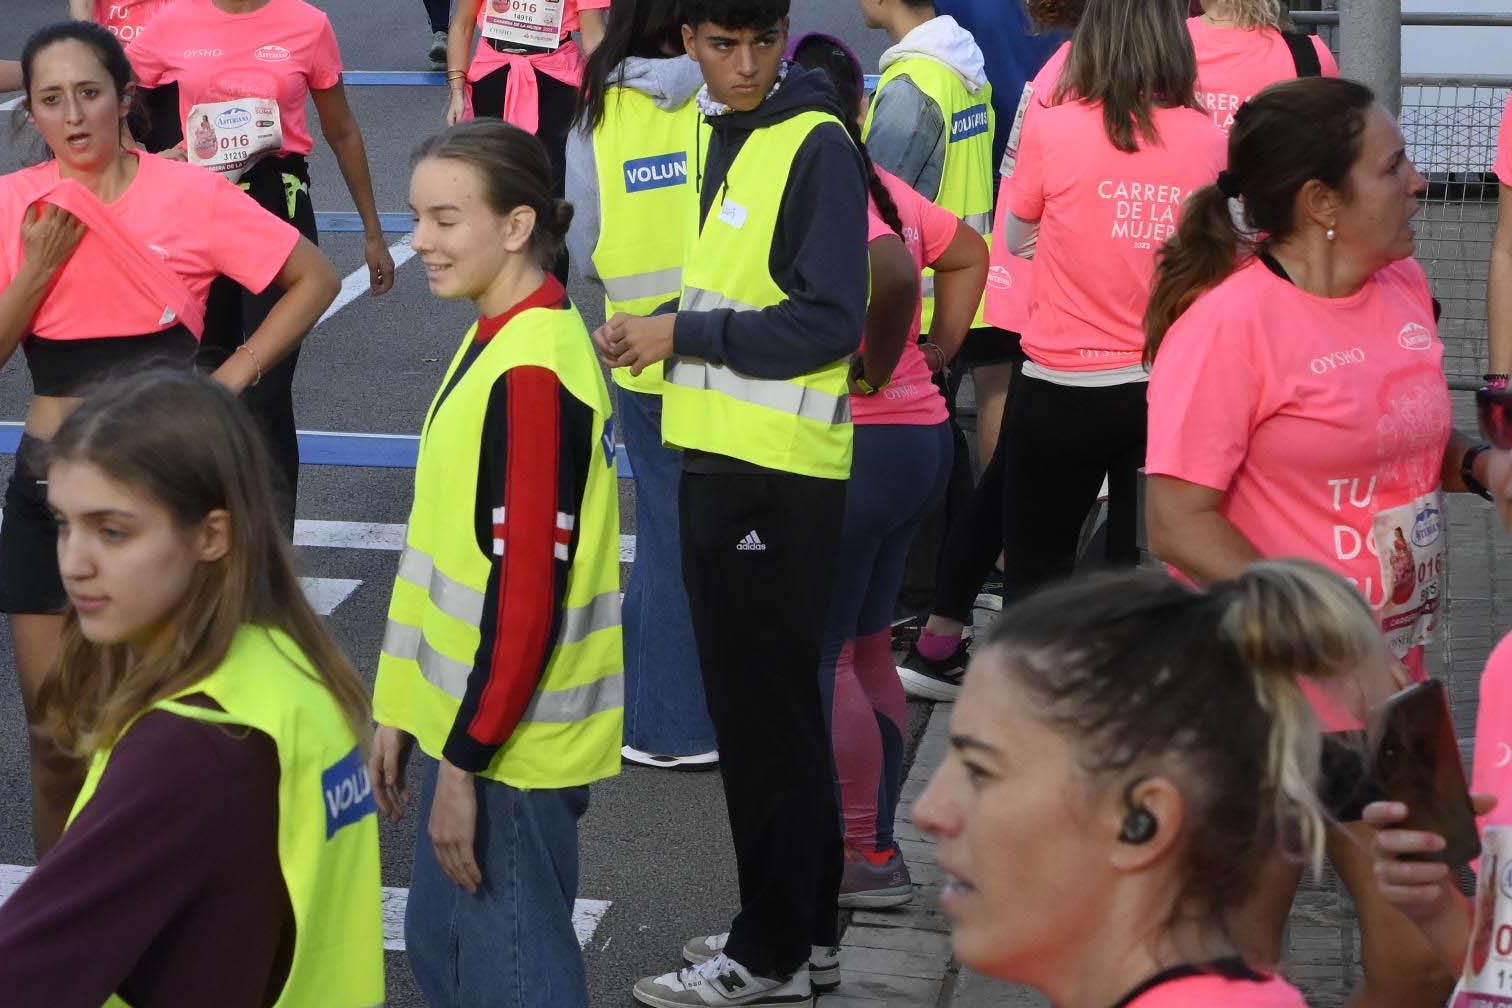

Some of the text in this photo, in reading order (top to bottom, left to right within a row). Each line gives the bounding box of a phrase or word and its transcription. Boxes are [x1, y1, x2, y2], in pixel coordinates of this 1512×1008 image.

[109, 5, 129, 20] TU
[512, 0, 537, 13] 016
[1200, 92, 1239, 112] RRER
[220, 134, 249, 149] 016
[223, 150, 248, 161] 31219
[626, 161, 687, 186] VOLUN
[1116, 201, 1174, 222] DE LA
[1111, 218, 1176, 241] MUJER
[1310, 348, 1366, 375] OYSHO
[1327, 475, 1376, 512] TU
[736, 543, 766, 551] adidas
